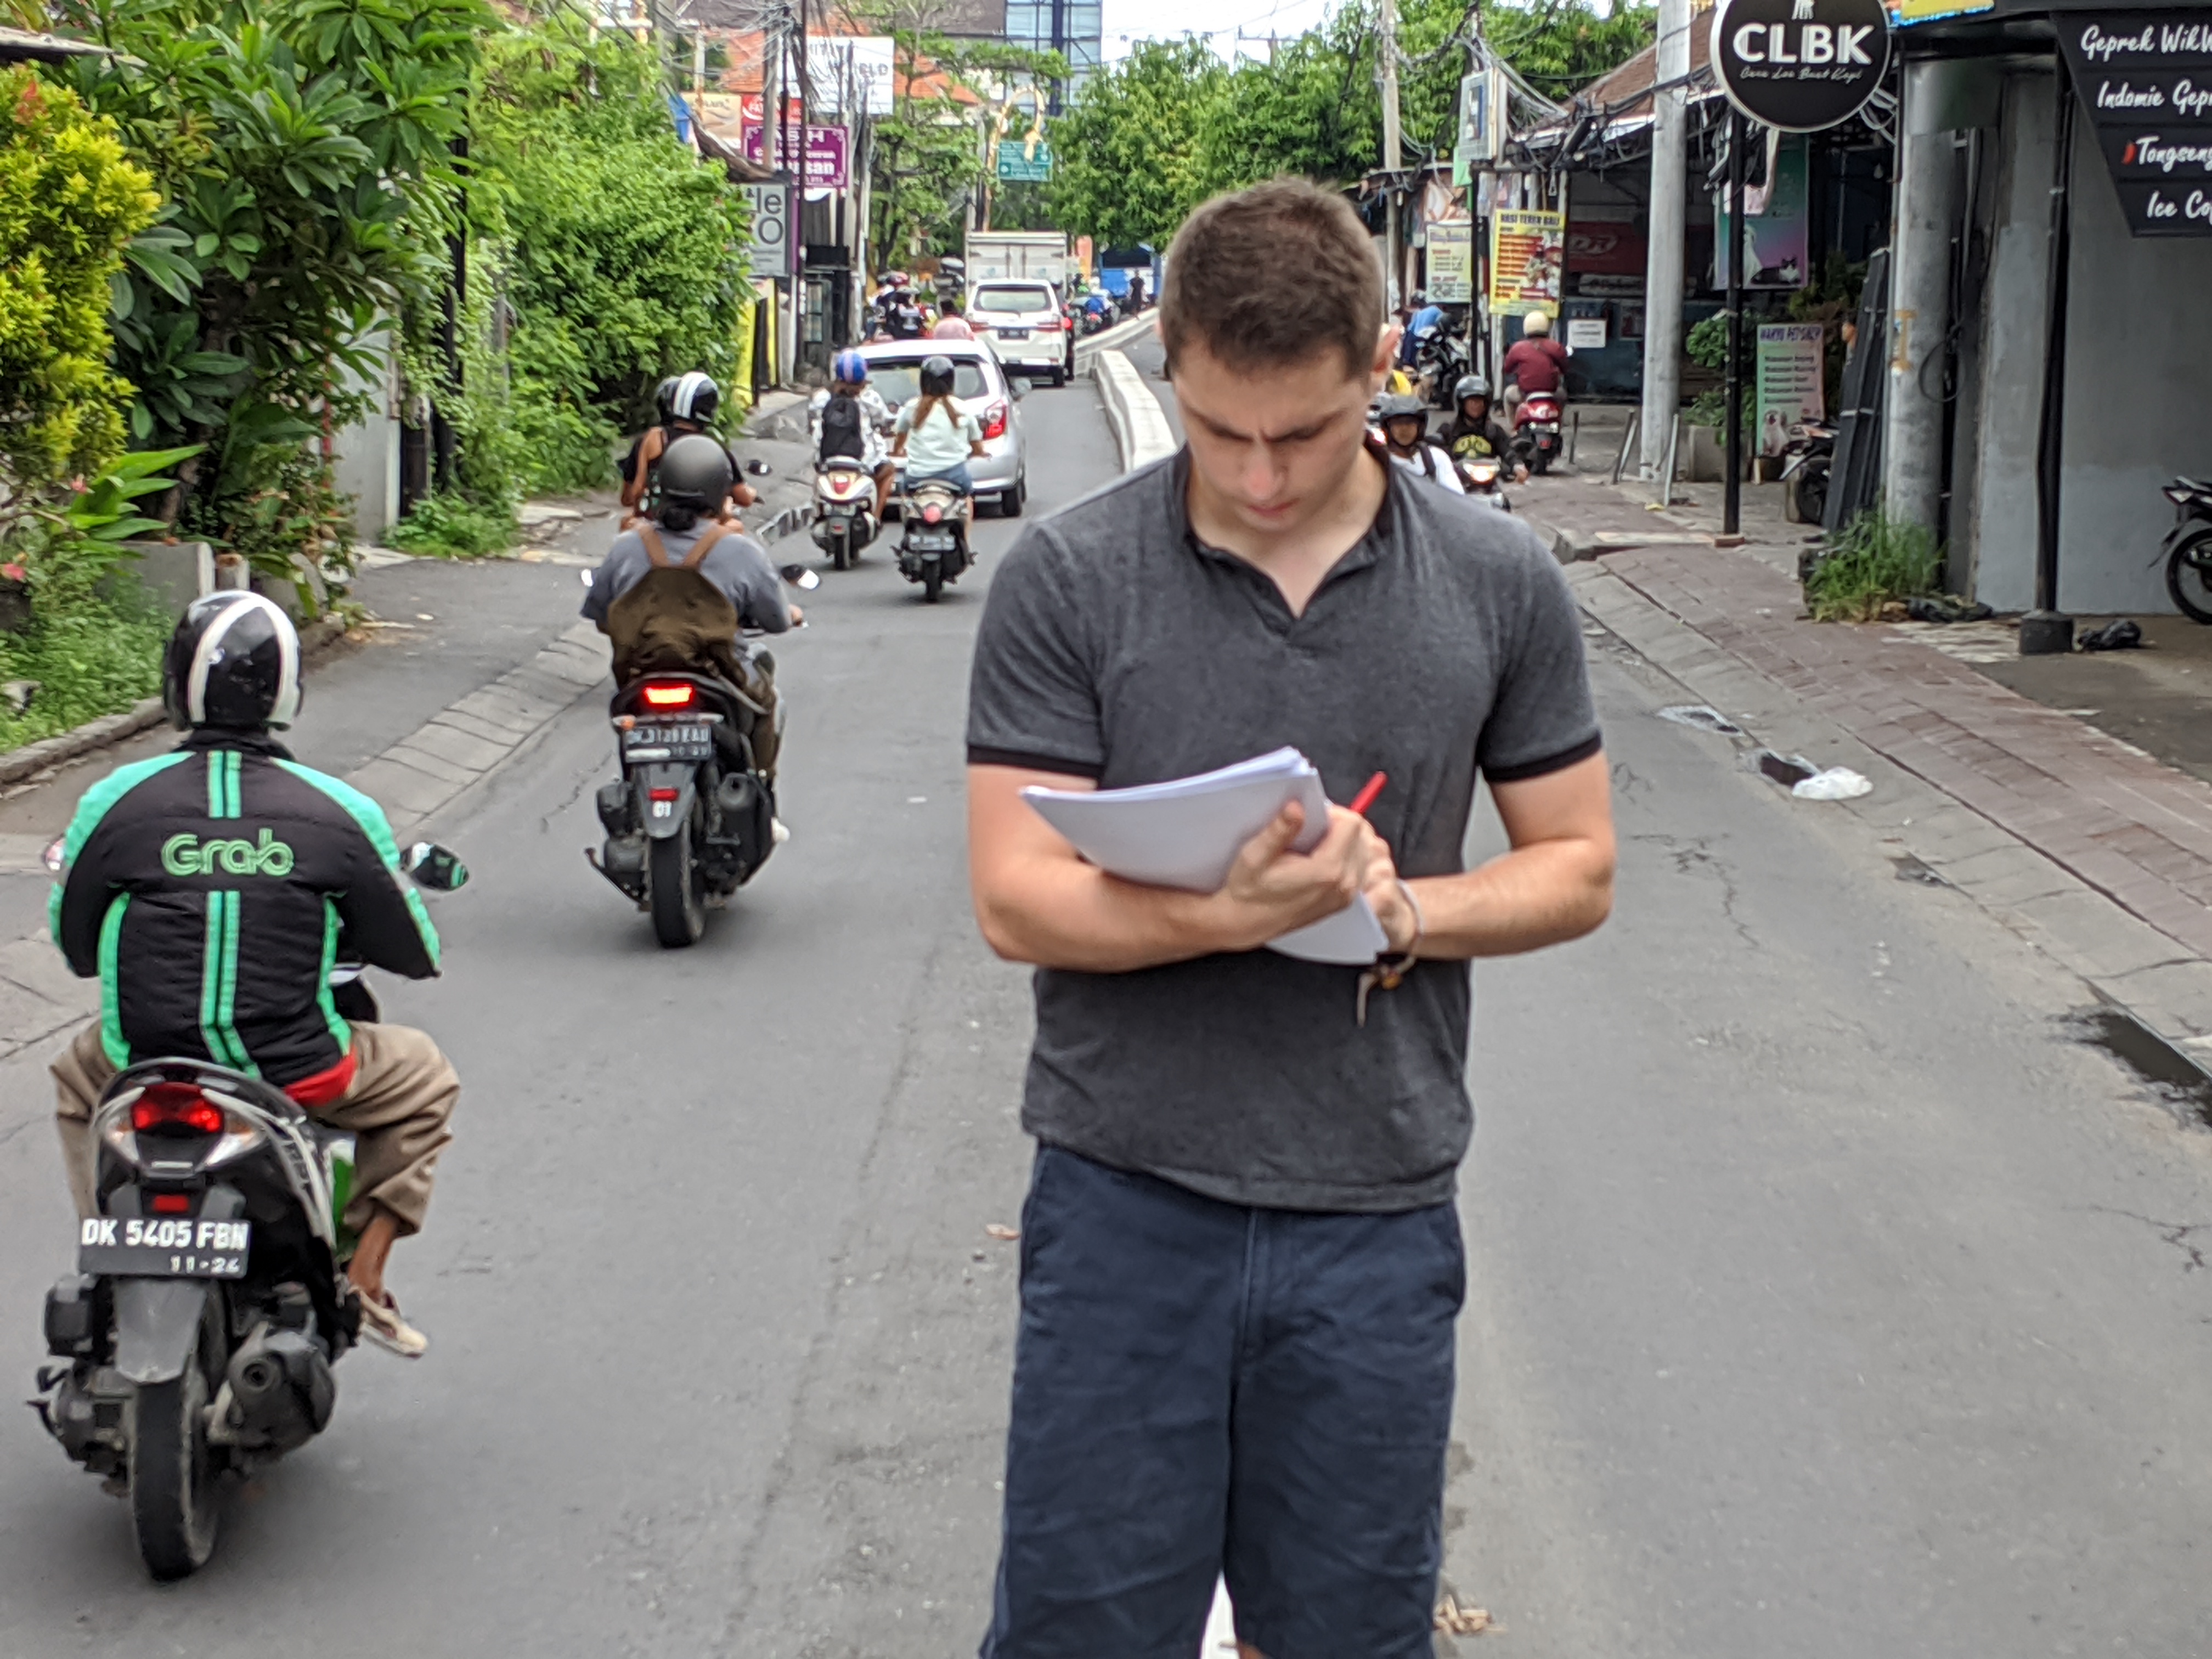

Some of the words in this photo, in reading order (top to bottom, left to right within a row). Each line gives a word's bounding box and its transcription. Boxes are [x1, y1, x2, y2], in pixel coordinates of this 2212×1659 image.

[1733, 22, 1875, 65] CLBK
[2080, 25, 2155, 62] Geprek
[2097, 81, 2165, 109] Indomie
[2172, 79, 2212, 117] Gep
[2147, 190, 2178, 218] Ice
[2185, 190, 2212, 226] Co
[161, 827, 294, 876] Grab
[82, 1218, 118, 1246] DK
[125, 1219, 192, 1248] 5405
[196, 1222, 249, 1251] FBN
